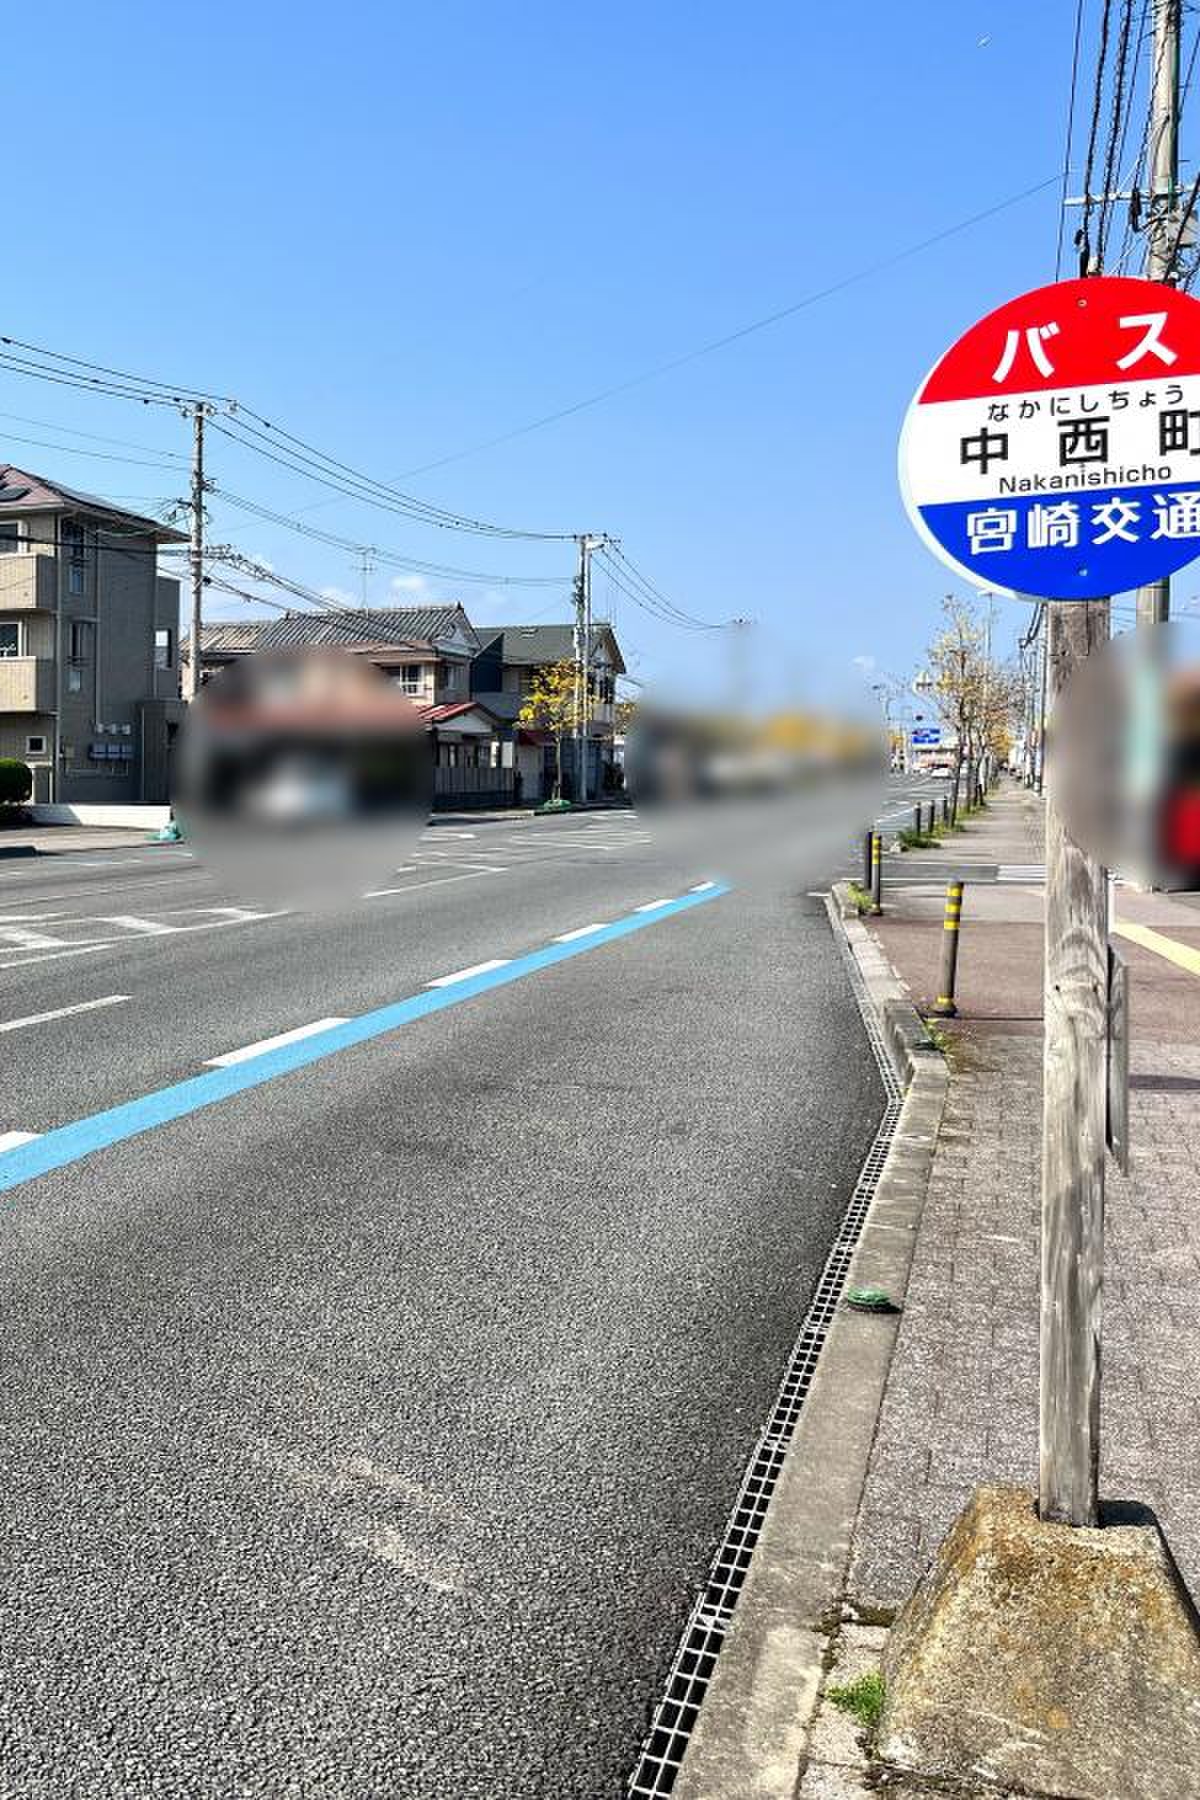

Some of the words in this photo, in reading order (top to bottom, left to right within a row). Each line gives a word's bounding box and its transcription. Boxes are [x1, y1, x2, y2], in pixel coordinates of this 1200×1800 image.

[992, 312, 1178, 383] バス
[988, 385, 1184, 422] なかにしちょう
[960, 409, 1200, 475] 中西町
[999, 465, 1172, 494] Nakanishicho
[966, 494, 1200, 556] 宮崎交通
